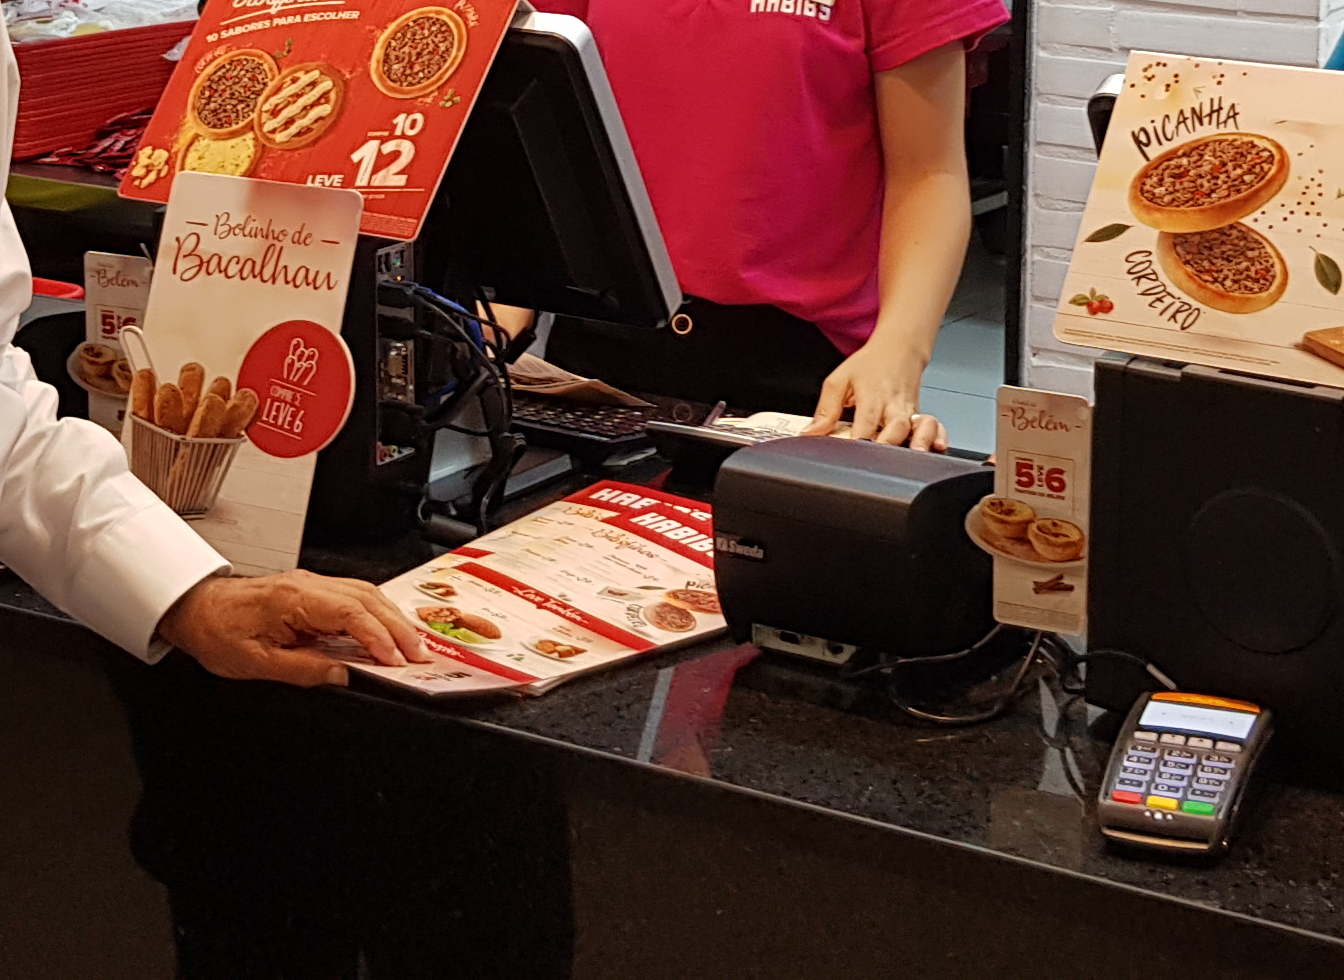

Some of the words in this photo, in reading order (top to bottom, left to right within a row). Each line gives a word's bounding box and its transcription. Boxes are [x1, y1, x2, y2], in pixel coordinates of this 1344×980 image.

[220, 19, 271, 40] SABORES
[272, 13, 302, 28] PARA
[303, 10, 360, 23] ESCOLHER
[392, 112, 425, 137] 10
[306, 174, 345, 187] LEVE
[350, 138, 416, 187] 12
[214, 211, 288, 243] Bolinho
[291, 223, 313, 246] de
[172, 231, 339, 292] Bacalhau
[101, 313, 116, 335] 5
[262, 398, 297, 430] LEVE
[293, 410, 305, 433] 6
[1011, 406, 1070, 432] Belém
[1015, 461, 1036, 489] 5
[1045, 467, 1067, 493] 6
